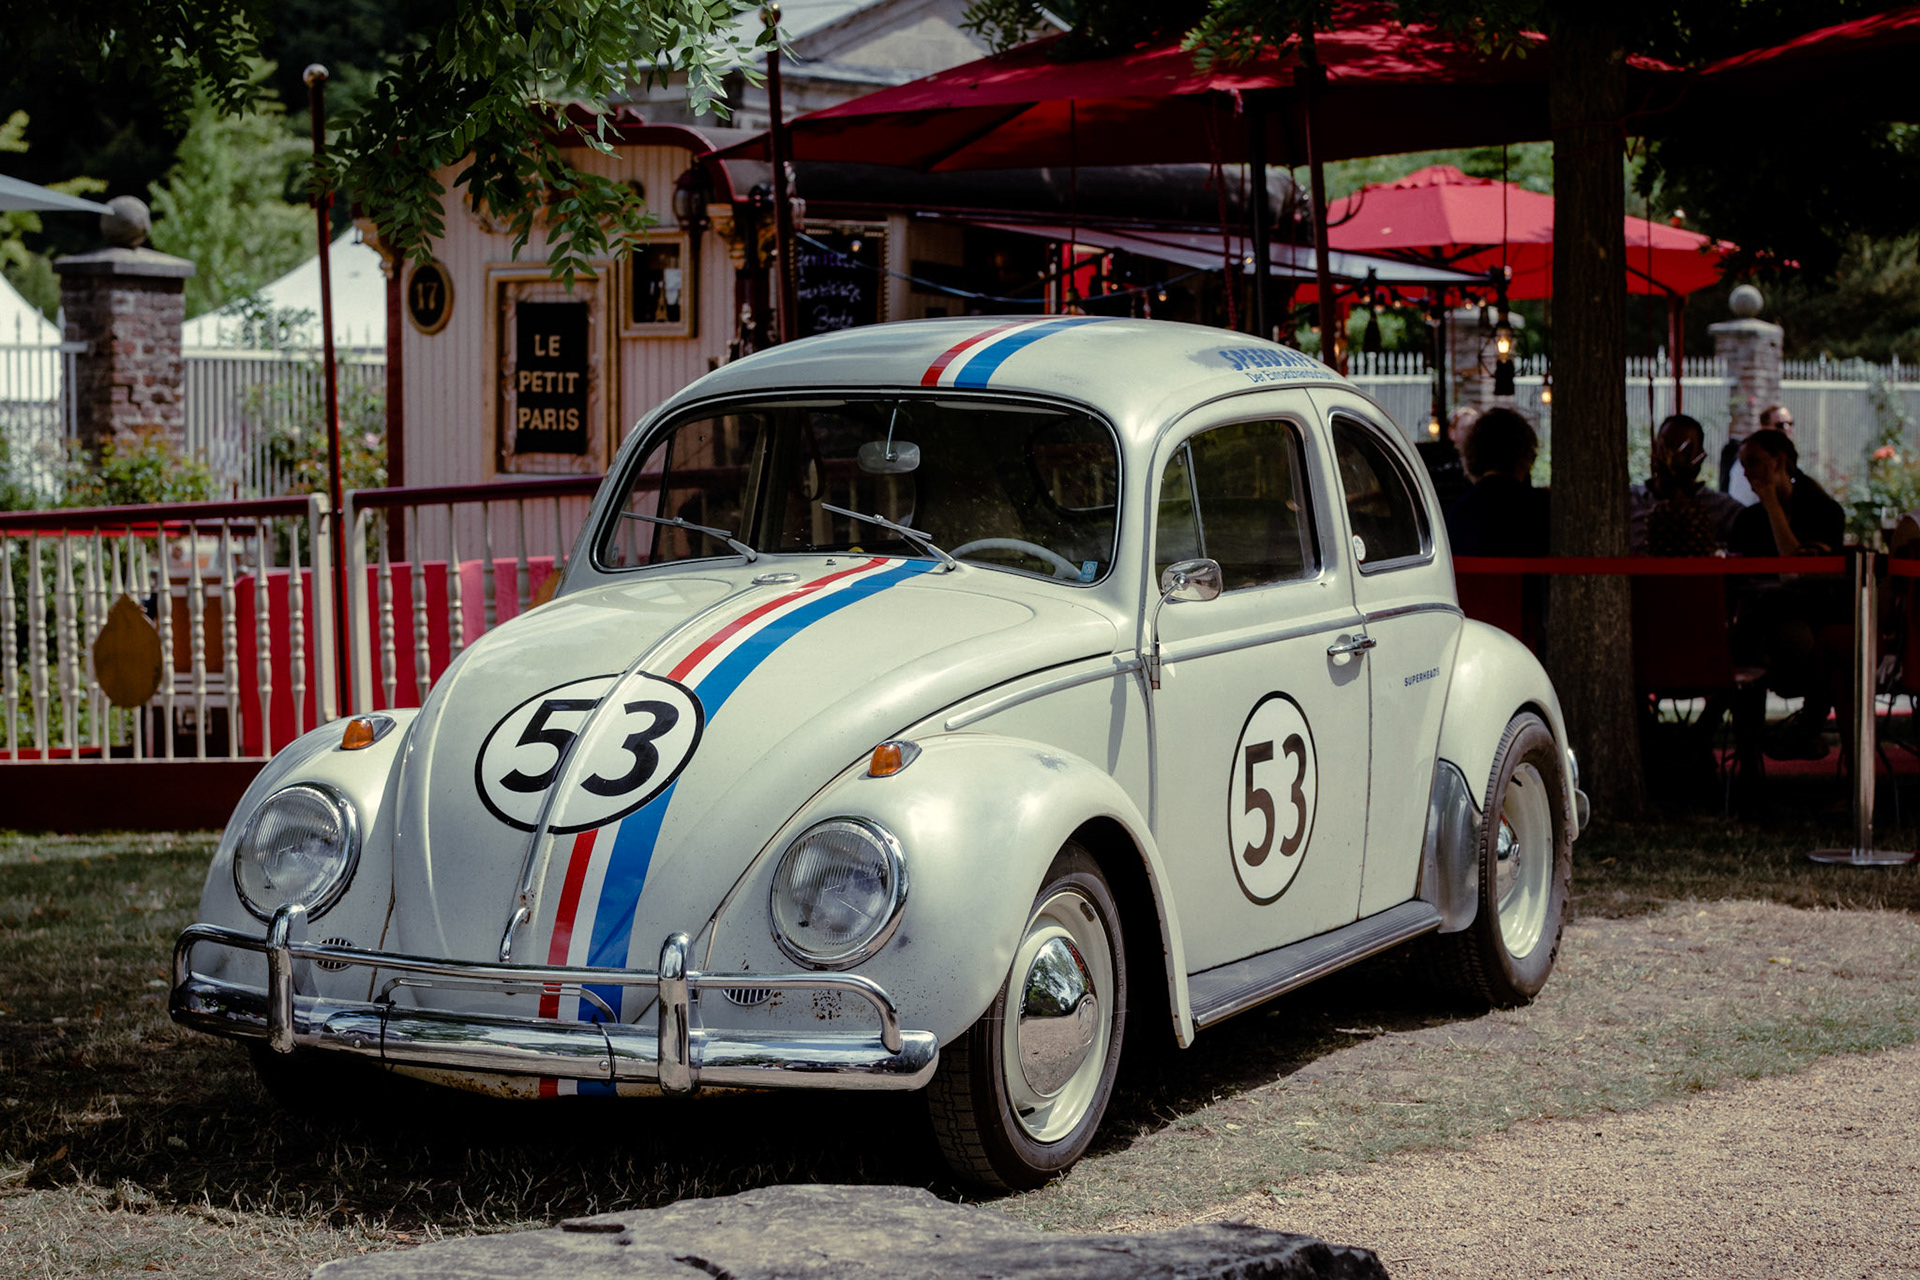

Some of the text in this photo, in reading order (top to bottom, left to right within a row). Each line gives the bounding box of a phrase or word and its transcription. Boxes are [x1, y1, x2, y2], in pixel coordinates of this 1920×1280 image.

[416, 281, 439, 311] 17
[534, 334, 561, 357] LE
[518, 371, 579, 394] PETIT
[517, 408, 579, 431] PARIS
[499, 697, 680, 797] 53
[1243, 733, 1307, 867] 53
